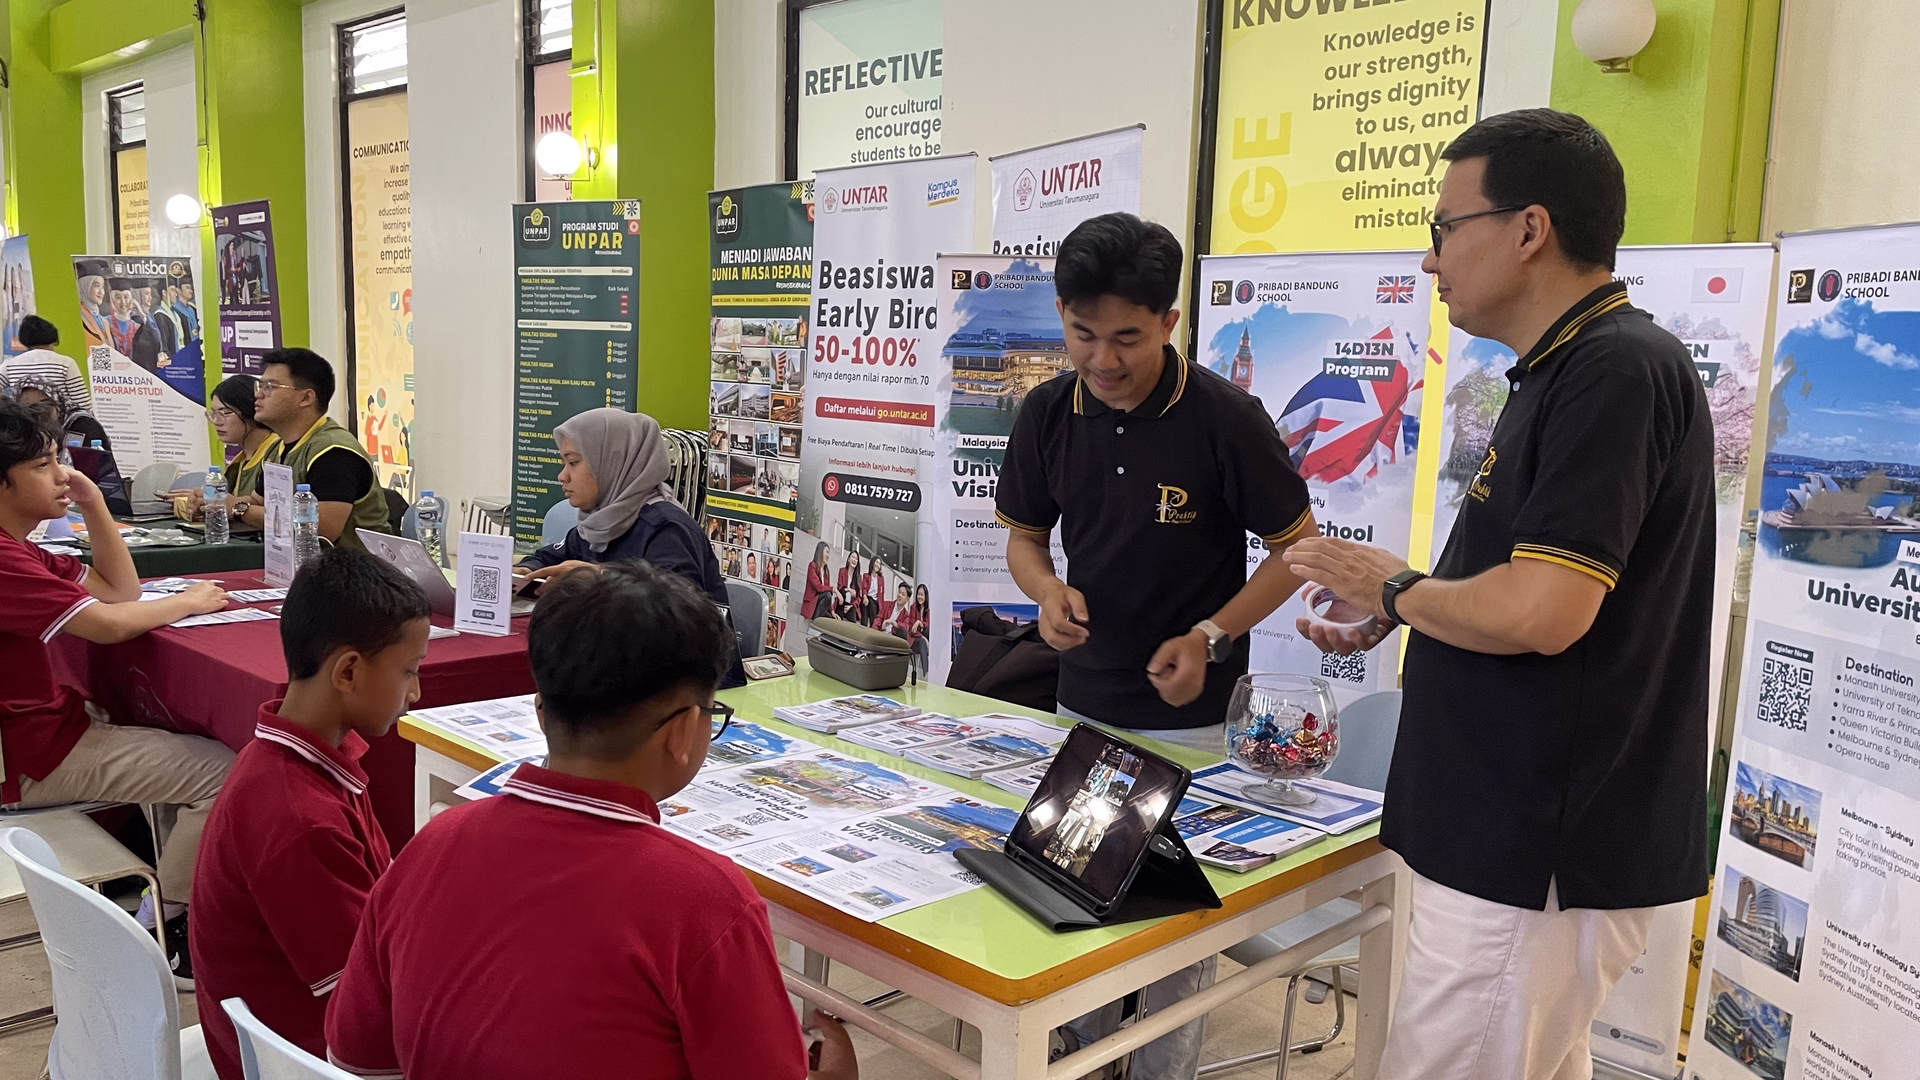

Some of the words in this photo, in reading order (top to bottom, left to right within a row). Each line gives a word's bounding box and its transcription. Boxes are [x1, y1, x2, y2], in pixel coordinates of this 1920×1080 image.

[1323, 19, 1450, 53] Knowledge
[1456, 12, 1475, 33] is
[1324, 61, 1361, 81] our
[1366, 44, 1473, 76] strength,
[805, 48, 943, 97] REFLECTIVE
[1312, 89, 1381, 112] brings
[1387, 75, 1471, 106] dignity
[865, 105, 888, 119] Our
[891, 95, 942, 116] cultural
[855, 117, 942, 141] encourage
[1355, 117, 1377, 135] to
[1383, 114, 1415, 134] us,
[1421, 105, 1469, 128] and
[850, 146, 905, 163] students
[908, 143, 921, 158] to
[925, 141, 941, 156] be
[390, 165, 399, 173] We
[1041, 158, 1102, 196] UNTAR
[384, 178, 408, 188] increase
[927, 179, 958, 192] Kampus
[842, 185, 888, 205] UNTAR
[927, 187, 960, 201] Merdeka
[378, 206, 407, 217] education
[525, 227, 548, 235] UNPAR
[562, 222, 596, 231] PROGRAM
[597, 222, 619, 231] STUDI
[717, 217, 736, 227] UNPAR
[562, 232, 624, 249] UNPAR
[721, 249, 761, 264] MENJADI
[763, 246, 812, 263] JAWABAN
[126, 260, 168, 276] unisba
[712, 267, 739, 281] DUNIA
[741, 265, 770, 280] MASA
[772, 264, 812, 279] DEPAN
[819, 259, 934, 290] Beasiswa
[994, 273, 1024, 281] PRIBADI
[994, 282, 1024, 290] SCHOOL
[1257, 281, 1293, 291] PRIBADI
[1293, 281, 1339, 291] BANDUNG
[1846, 271, 1891, 284] PRIBADI
[1257, 293, 1292, 302] SCHOOL
[1845, 287, 1890, 299] SCHOOL
[816, 297, 879, 336] Early
[888, 297, 937, 330] Bird
[1335, 342, 1394, 357] 14D13N
[812, 370, 832, 380] Hanya
[833, 371, 861, 383] dengan
[863, 372, 880, 383] nilai
[881, 376, 903, 386] rapor
[904, 375, 919, 385] min.
[920, 375, 930, 385] 70
[1325, 362, 1389, 379] Program
[92, 375, 133, 385] FAKULTAS
[134, 376, 153, 386] DAN
[93, 385, 136, 396] PROGRAM
[137, 386, 163, 396] STUDI
[824, 403, 847, 415] Daftar
[848, 405, 876, 416] melalui
[877, 408, 928, 421] go.untar.ac.id
[817, 437, 831, 446] Biaya
[831, 438, 864, 449] Pendaftaran
[868, 442, 881, 452] Real
[882, 443, 896, 453] Time
[900, 445, 918, 455] Dibuka
[918, 447, 935, 458] Setiap
[828, 457, 856, 468] Informasi
[857, 461, 871, 469] lebih
[872, 462, 890, 472] lanjut
[891, 464, 917, 475] hubungi:
[844, 482, 868, 496] 0811
[870, 486, 895, 500] 7579
[896, 490, 914, 502] 727
[970, 539, 982, 548] City
[962, 552, 984, 561] Genting
[962, 566, 992, 575] University
[1262, 629, 1295, 642] University
[1770, 643, 1793, 657] Register
[1793, 648, 1809, 660] Now
[1845, 657, 1914, 687] Destination
[1844, 674, 1879, 692] Monash
[1842, 688, 1885, 710] University
[1885, 699, 1895, 711] of
[1841, 703, 1865, 719] Yarra
[1866, 709, 1888, 725] River
[1839, 715, 1868, 734] Queen
[1869, 724, 1902, 744] Victoria
[1838, 729, 1883, 754] Melbourne
[1835, 744, 1862, 762] Opera
[1863, 754, 1890, 771] House
[705, 780, 756, 799] Heritage
[754, 799, 809, 820] Program
[736, 783, 796, 806] University
[1841, 807, 1878, 829] Melbourne
[841, 825, 880, 842] Visit
[855, 821, 941, 855] University
[1837, 838, 1866, 858] Sydney,
[1867, 851, 1893, 872] visiting
[1838, 826, 1854, 840] City
[1855, 833, 1870, 846] tour
[1879, 844, 1920, 869] Melbourne
[1836, 849, 1860, 868] taking
[1823, 936, 1836, 949] The
[1837, 944, 1872, 971] University
[1826, 920, 1861, 947] University
[1872, 943, 1908, 972] Teknology
[1821, 947, 1848, 969] Sydney
[1819, 958, 1857, 985] innovative
[1858, 981, 1893, 1007] university
[1809, 1030, 1836, 1053] Monash
[1837, 1047, 1873, 1079] University
